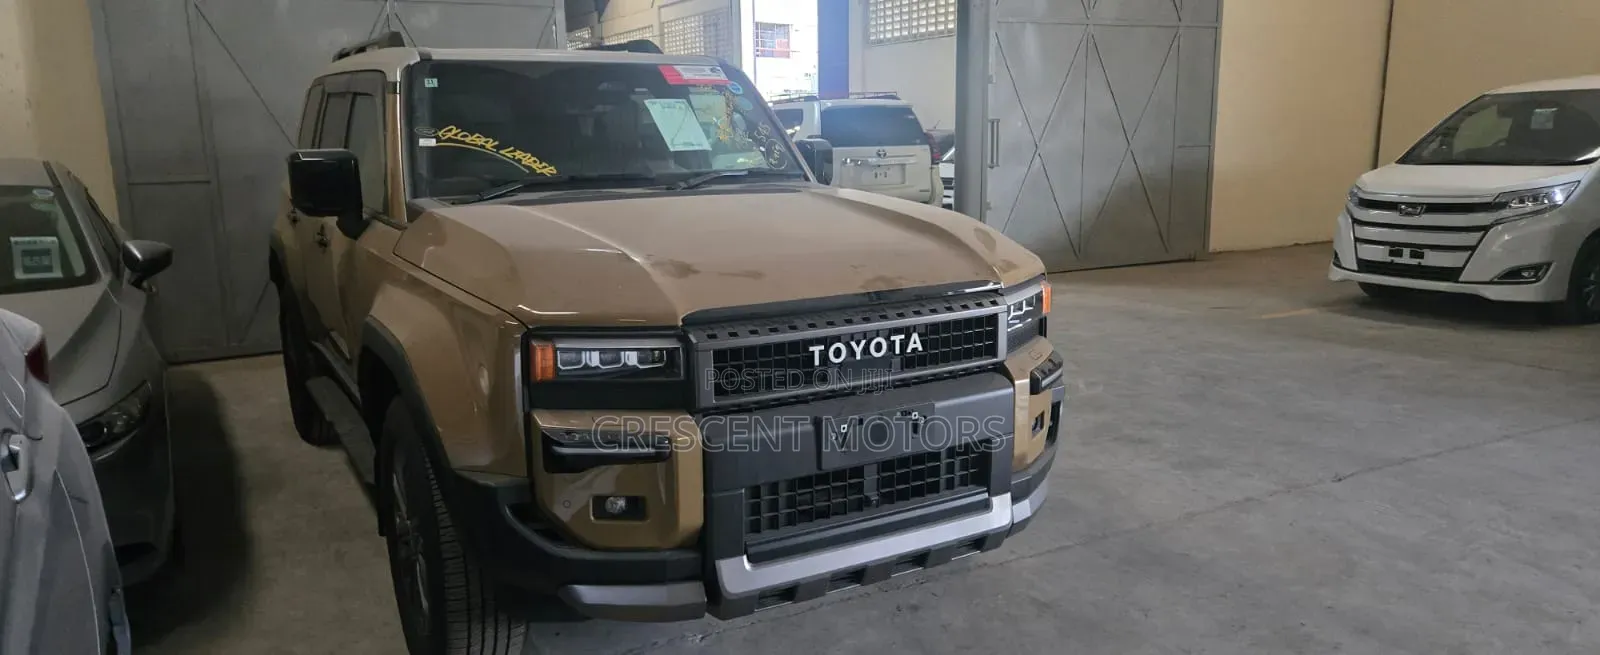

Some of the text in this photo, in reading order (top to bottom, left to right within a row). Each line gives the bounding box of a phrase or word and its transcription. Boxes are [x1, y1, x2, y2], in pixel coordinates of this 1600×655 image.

[438, 125, 558, 177] GLOBAL LEADER
[809, 332, 924, 366] TOYOTA
